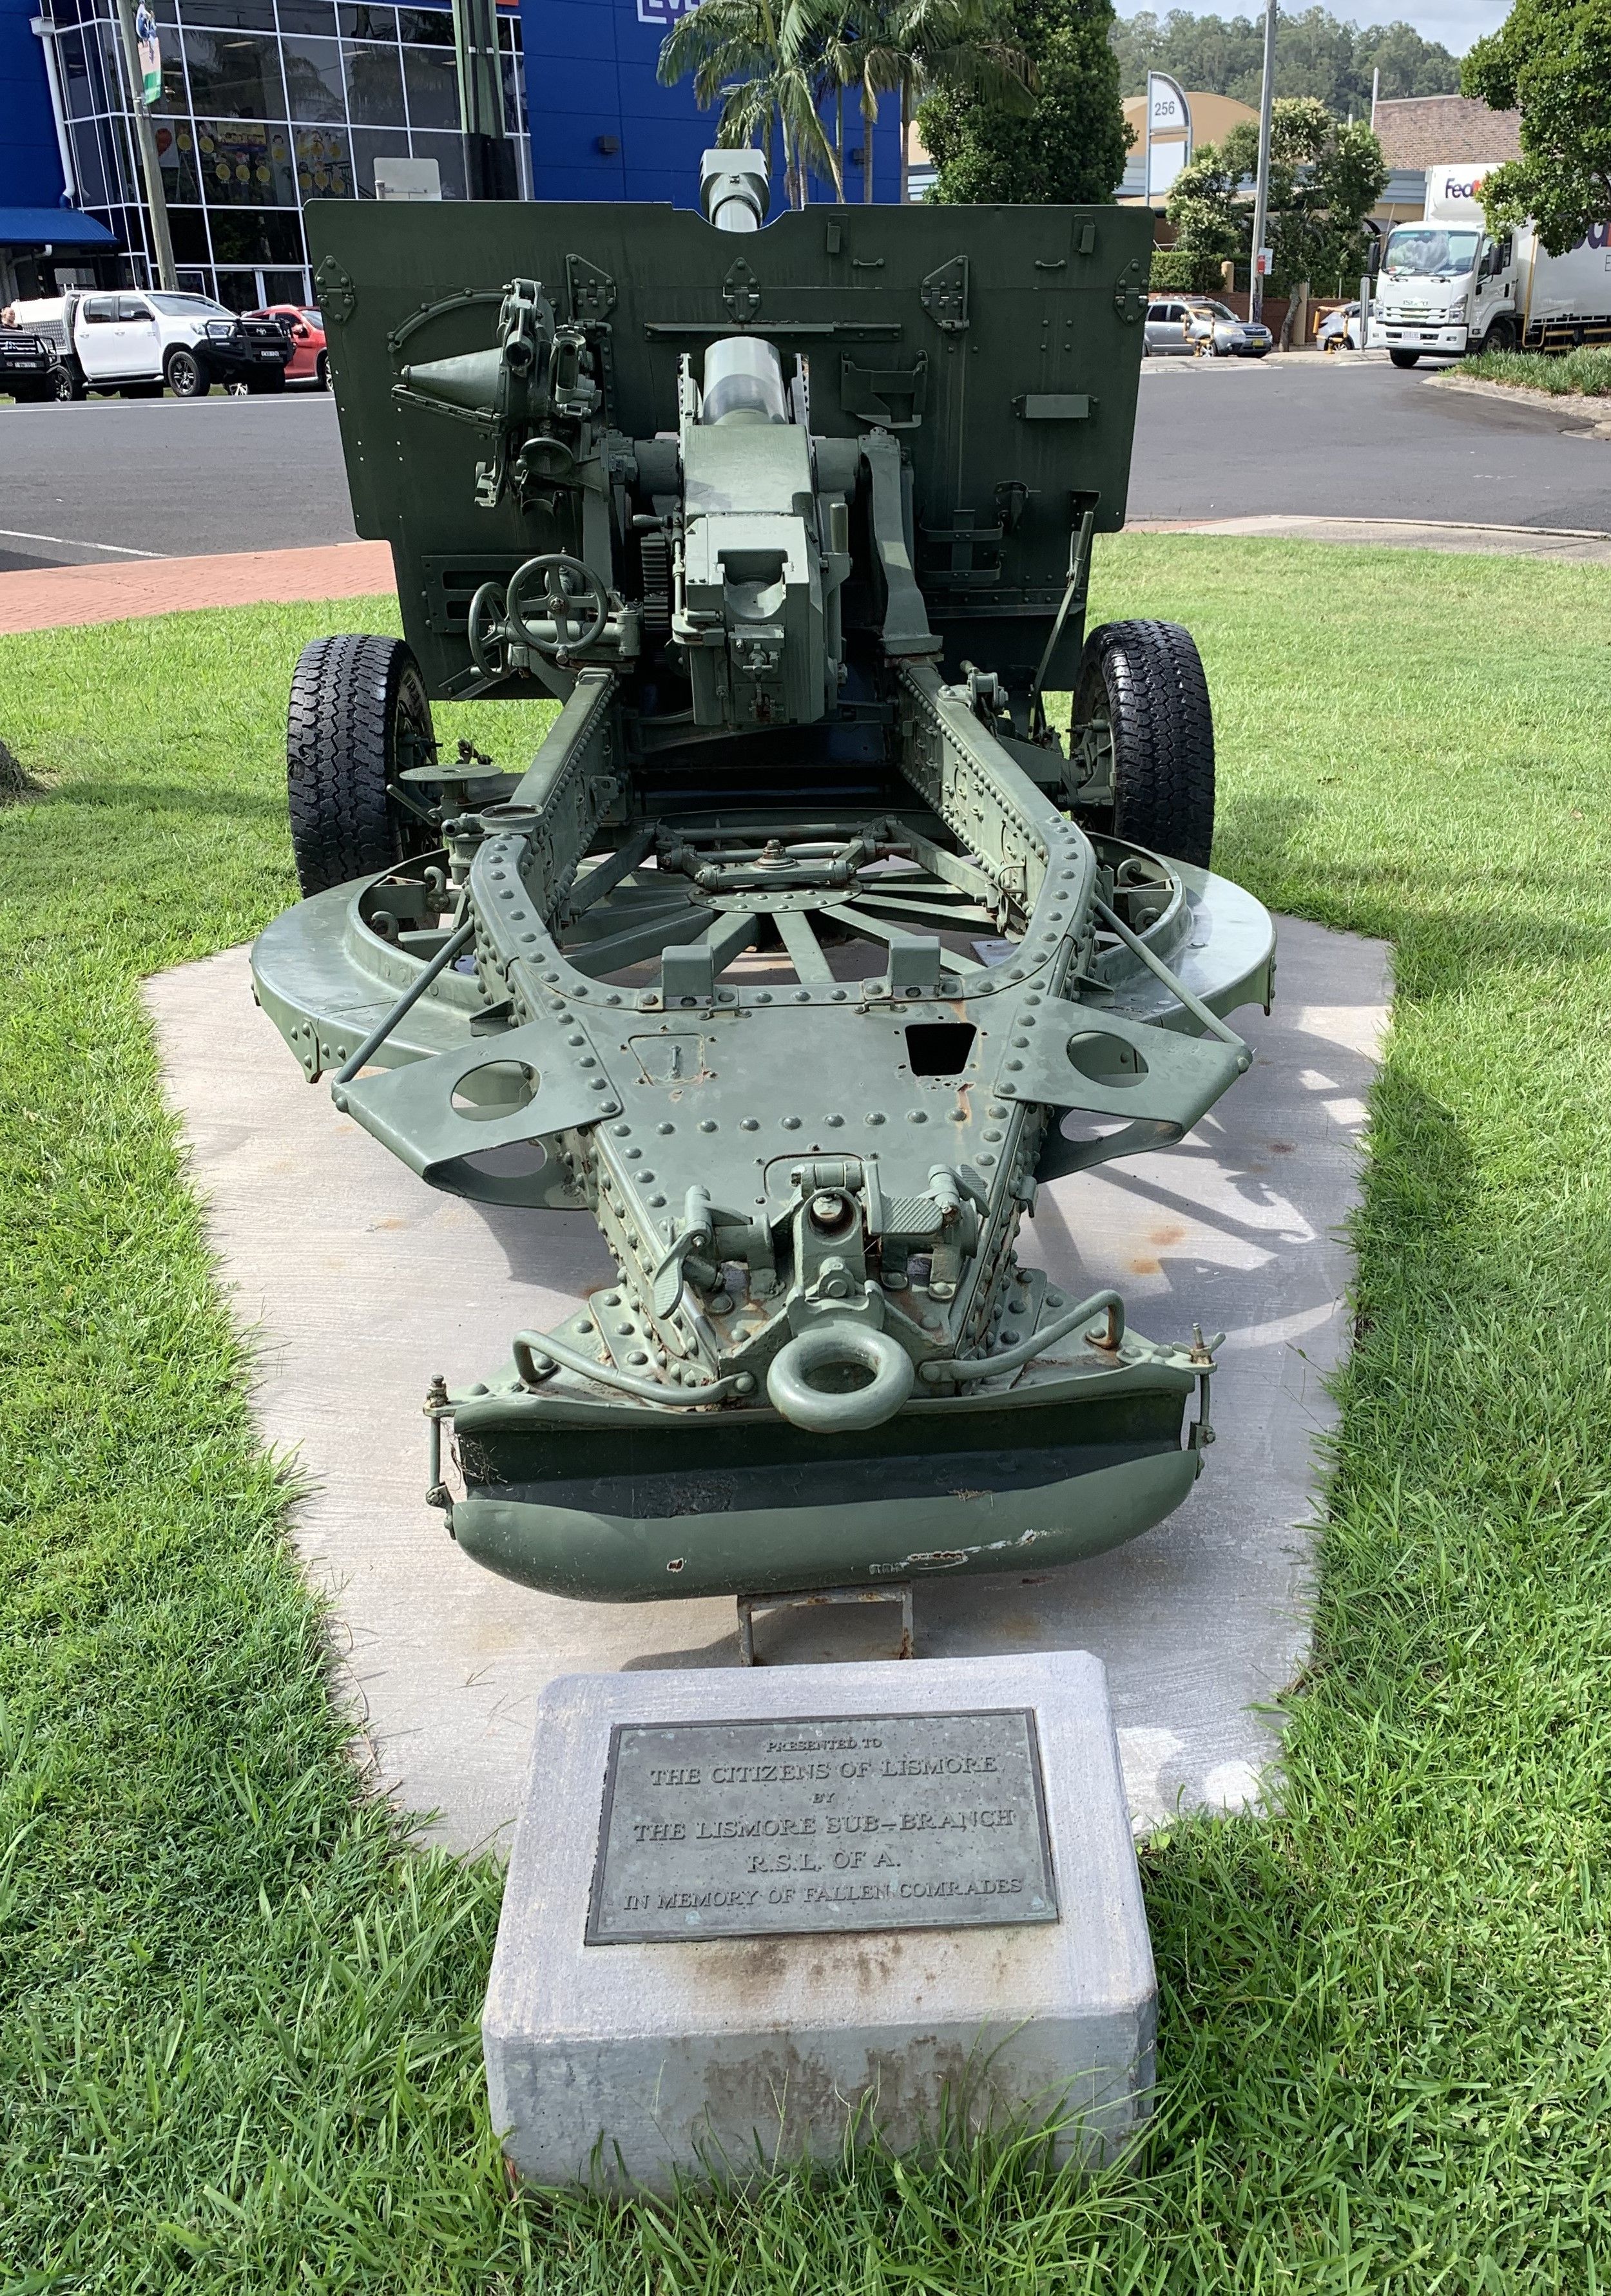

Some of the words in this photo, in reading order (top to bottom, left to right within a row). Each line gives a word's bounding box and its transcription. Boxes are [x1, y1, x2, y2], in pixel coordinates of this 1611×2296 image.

[1154, 100, 1175, 116] 256
[1445, 177, 1481, 199] Fed
[766, 1739, 858, 1752] PRESENTED
[861, 1738, 883, 1748] TO
[650, 1769, 701, 1786] THE
[711, 1764, 830, 1784] CITIZENS
[840, 1762, 872, 1778] OF
[882, 1757, 998, 1777] LISMORE
[813, 1793, 835, 1804] BY
[633, 1824, 686, 1842] THE
[696, 1818, 816, 1839] LISMORE
[825, 1810, 1014, 1834] SUB-BRANCH
[748, 1853, 822, 1873] R.S.L.
[834, 1851, 867, 1868] OF
[873, 1851, 901, 1868] A.
[624, 1895, 650, 1910] IN
[657, 1891, 761, 1909] MEMORY
[768, 1889, 796, 1904] OF
[804, 1884, 890, 1902] FALLEN
[900, 1879, 1023, 1898] COMRADES
